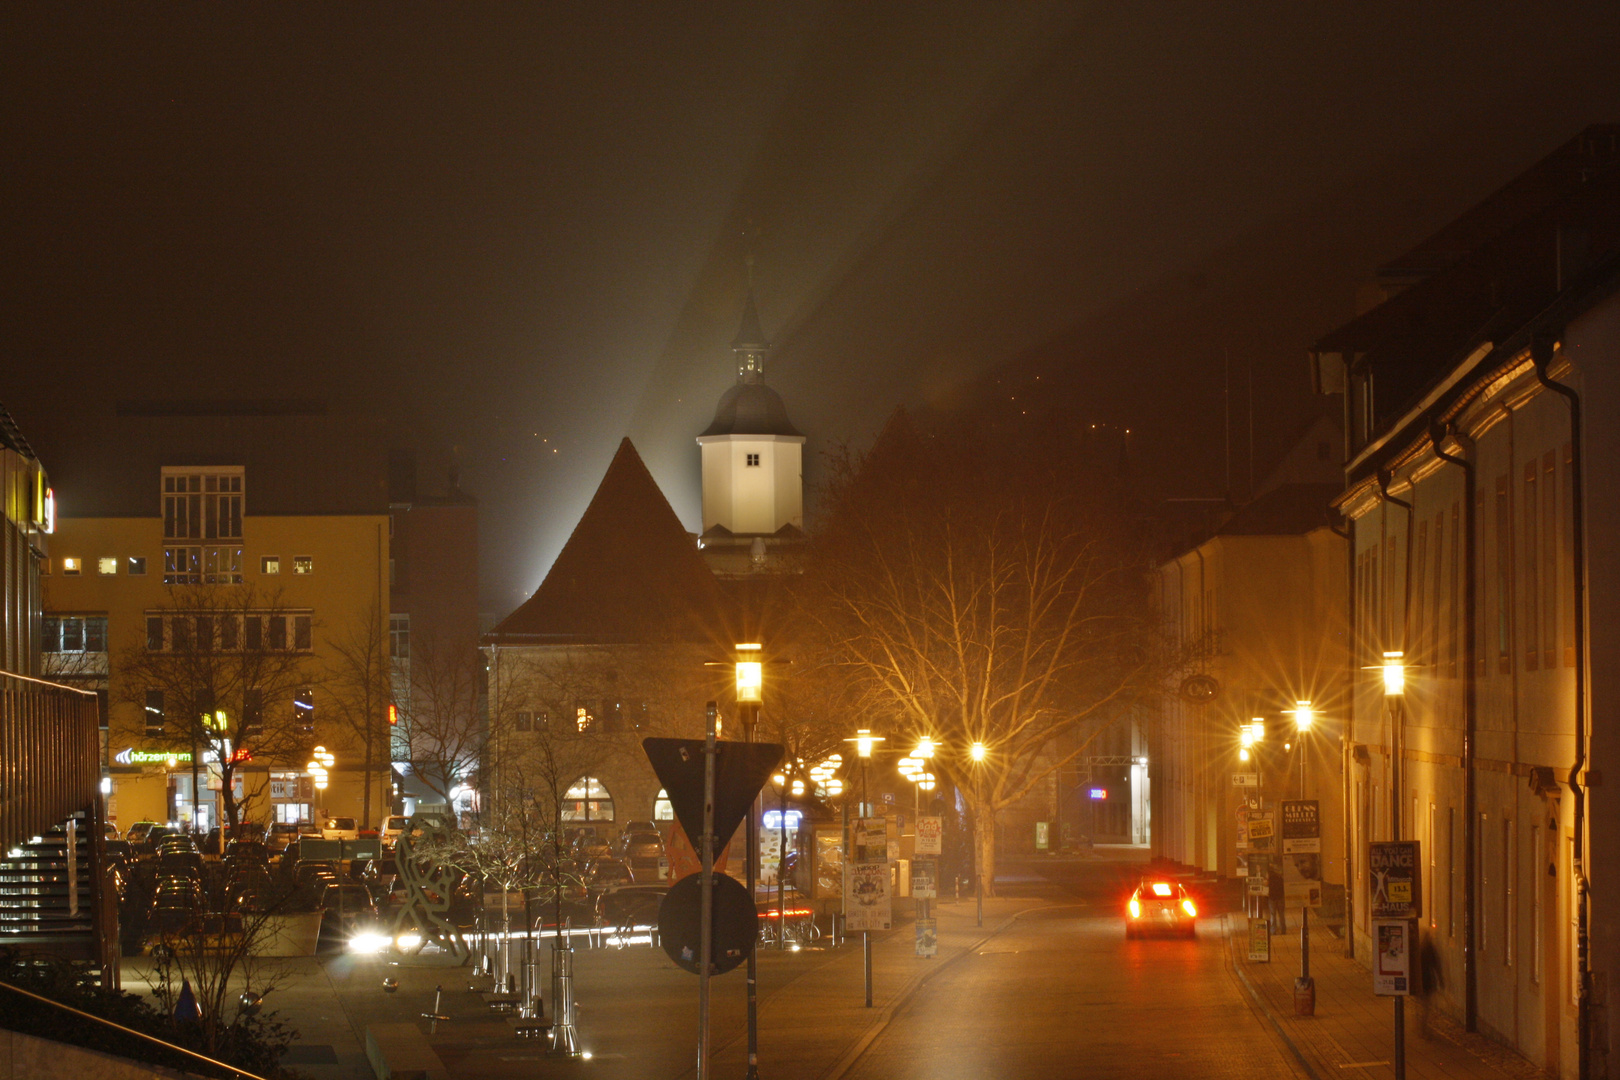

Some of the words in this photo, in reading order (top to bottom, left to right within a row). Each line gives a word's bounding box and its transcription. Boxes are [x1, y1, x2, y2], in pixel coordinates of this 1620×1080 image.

[131, 751, 192, 762] hörzentrum
[270, 783, 285, 794] tik
[1384, 847, 1399, 855] YOU
[1371, 855, 1413, 868] DANCE
[1371, 903, 1410, 912] F-HAUS
